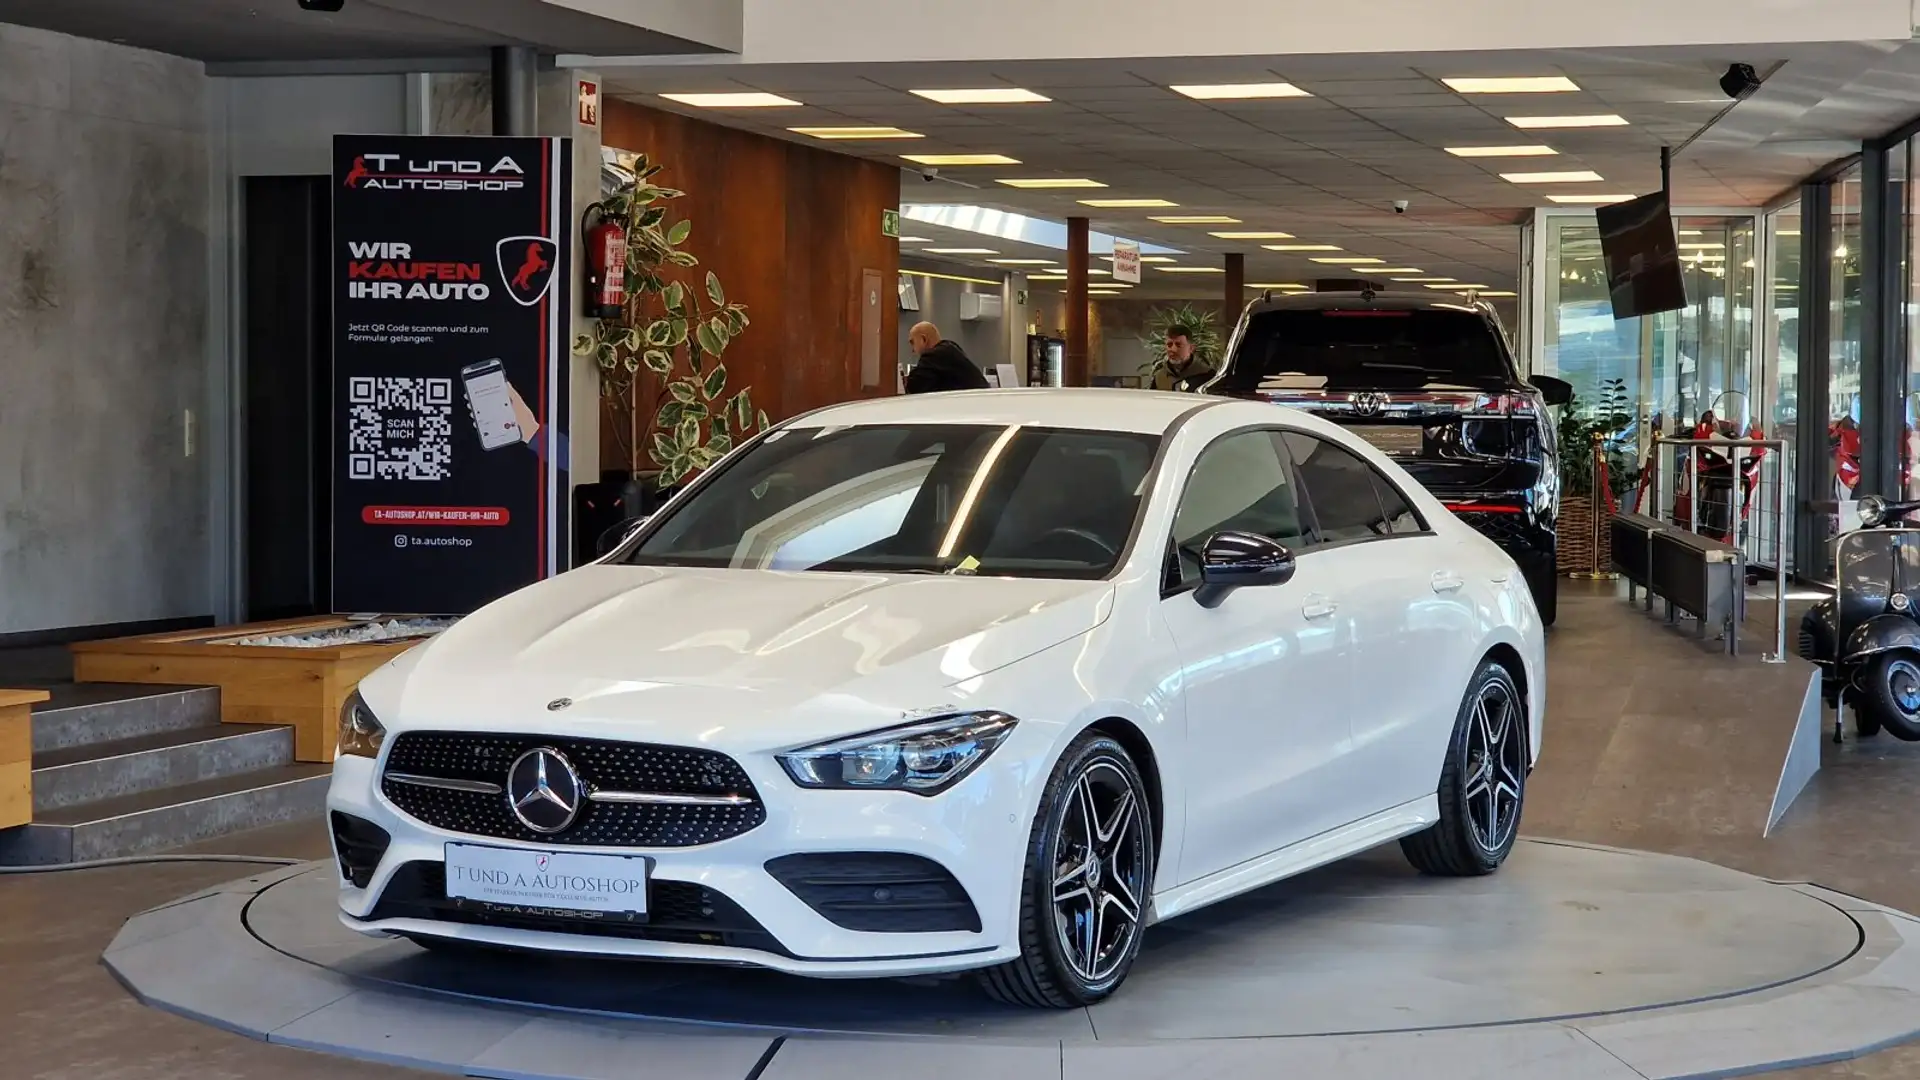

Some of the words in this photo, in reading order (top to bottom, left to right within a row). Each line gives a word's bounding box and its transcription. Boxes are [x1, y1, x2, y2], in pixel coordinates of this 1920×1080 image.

[364, 153, 400, 172] T
[489, 155, 524, 174] A
[363, 178, 524, 191] AUTOSHOP
[348, 241, 412, 259] WIR
[348, 261, 480, 280] KAUFEN
[349, 281, 402, 298] IHR
[405, 282, 490, 300] AUTO
[348, 323, 370, 332] Jetzt
[371, 324, 385, 333] QR
[387, 323, 410, 332] Code
[411, 325, 448, 333] scannen
[450, 324, 468, 333] und
[348, 333, 388, 342] Formular
[390, 334, 434, 345] gelangen:
[387, 418, 414, 428] SCAN
[387, 429, 414, 439] MICH
[411, 537, 472, 547] ta.autoshop
[453, 865, 465, 880] T
[469, 867, 509, 886] UND
[514, 872, 527, 887] A
[532, 874, 640, 894] AUTOSHOP
[526, 906, 603, 919] AUTOSHOP
